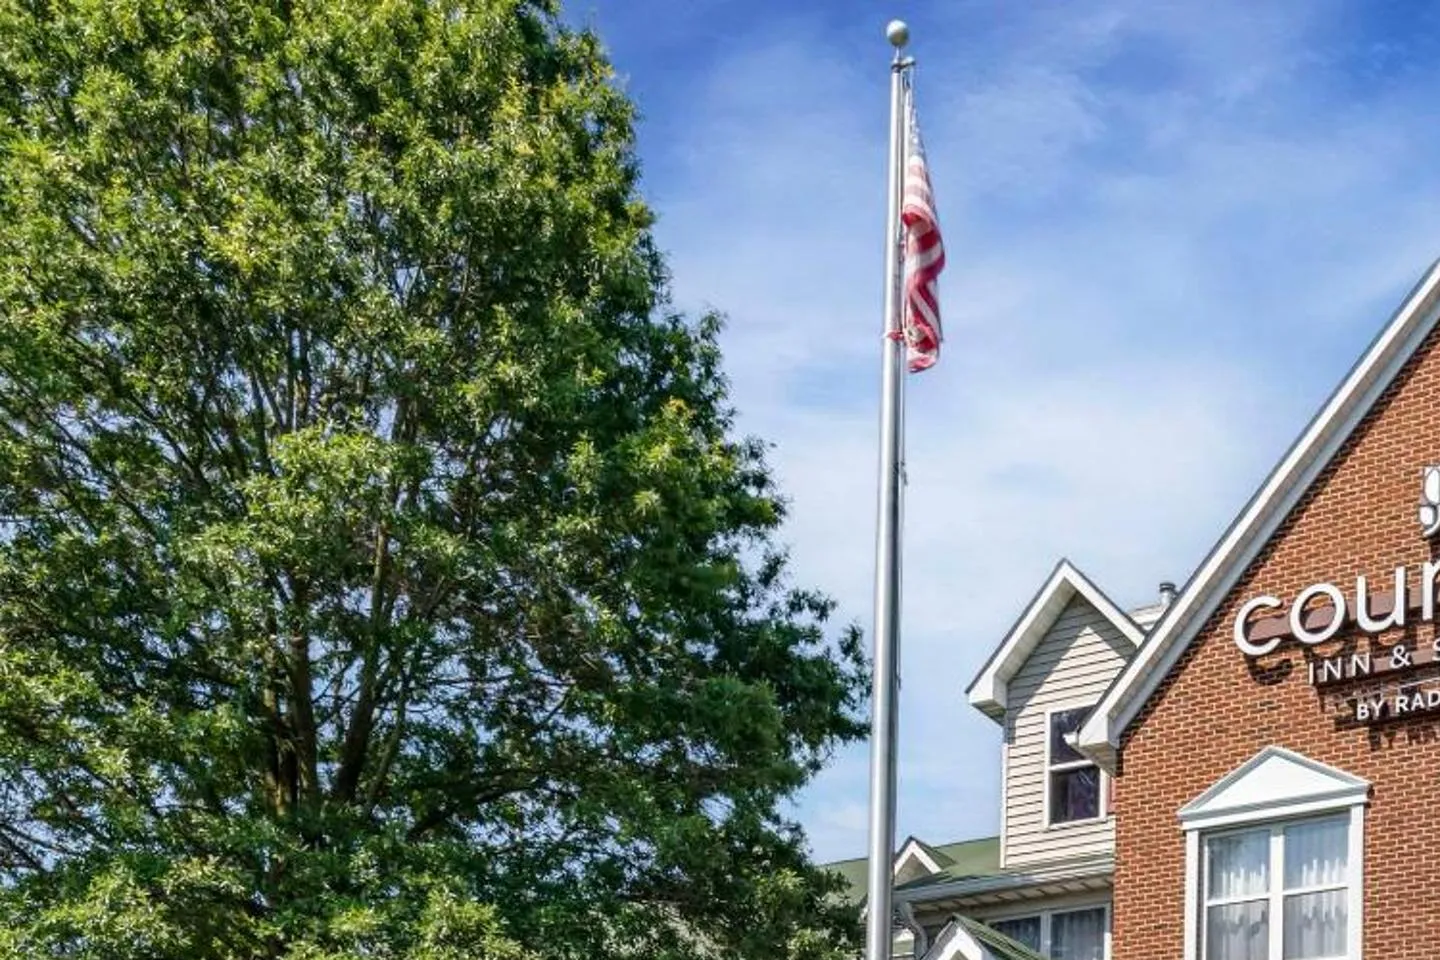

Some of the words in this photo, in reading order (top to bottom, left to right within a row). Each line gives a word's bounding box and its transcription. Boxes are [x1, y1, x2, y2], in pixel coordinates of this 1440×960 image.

[1308, 652, 1372, 684] INN
[1390, 645, 1412, 669] &
[1356, 699, 1385, 721] BY
